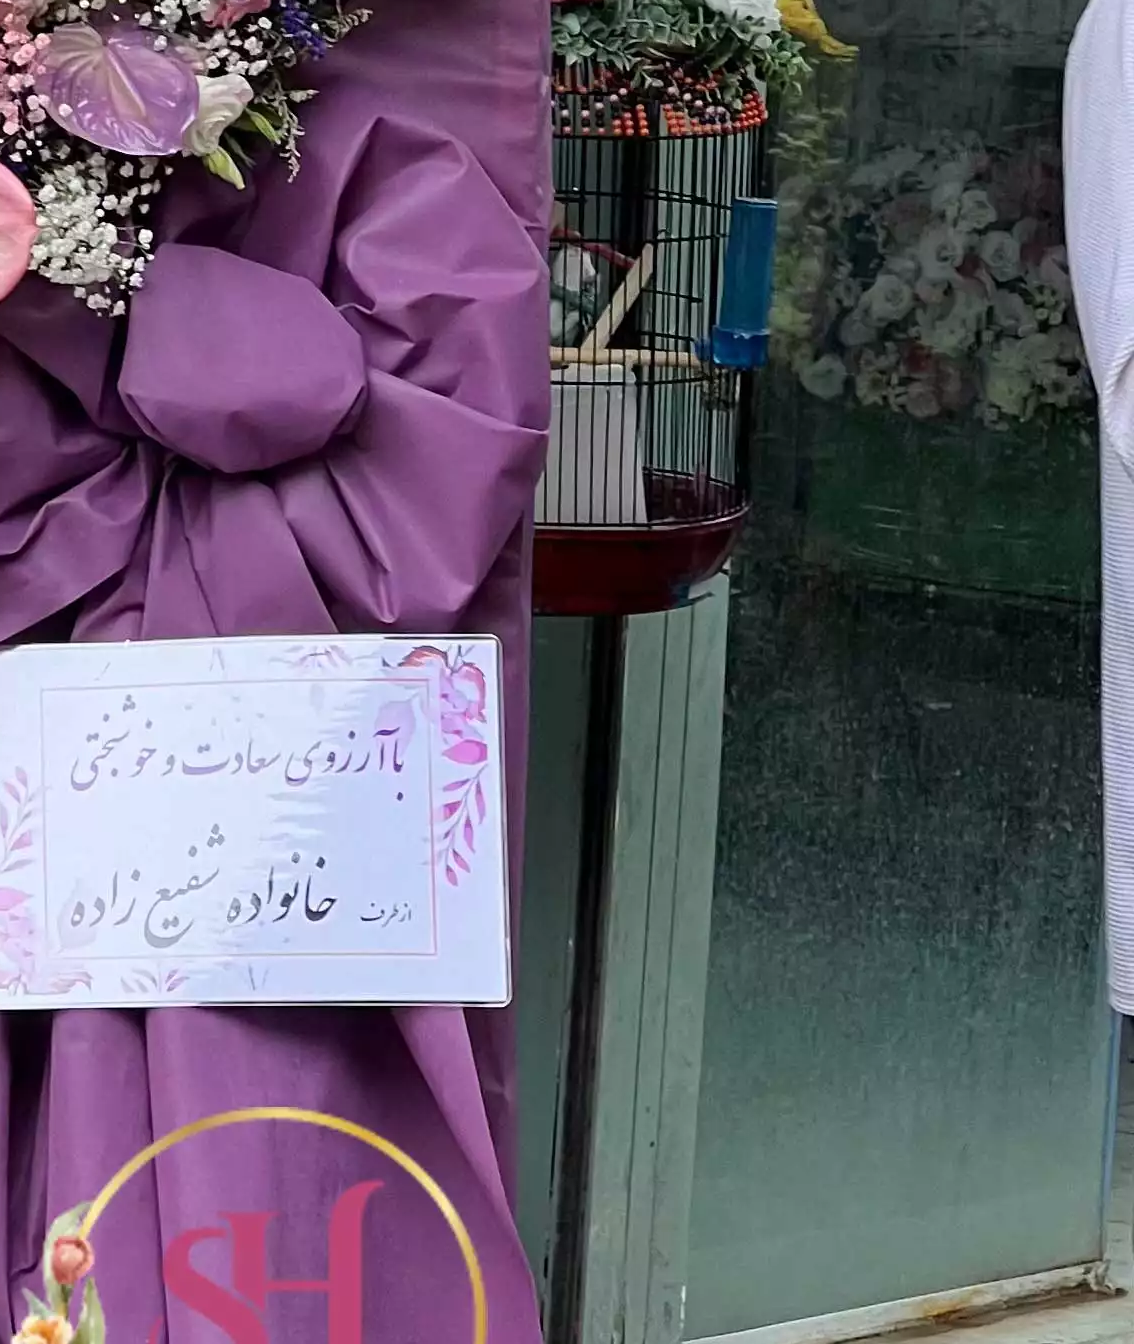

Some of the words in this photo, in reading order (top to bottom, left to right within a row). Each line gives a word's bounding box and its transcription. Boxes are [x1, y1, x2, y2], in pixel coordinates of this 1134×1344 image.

[69, 693, 158, 792] خوشبختی
[160, 752, 177, 777] و
[181, 734, 282, 776] سعادت
[285, 726, 401, 787] آرزوی
[392, 737, 405, 802] با
[70, 867, 142, 928] زاده
[226, 851, 339, 926] خانواده
